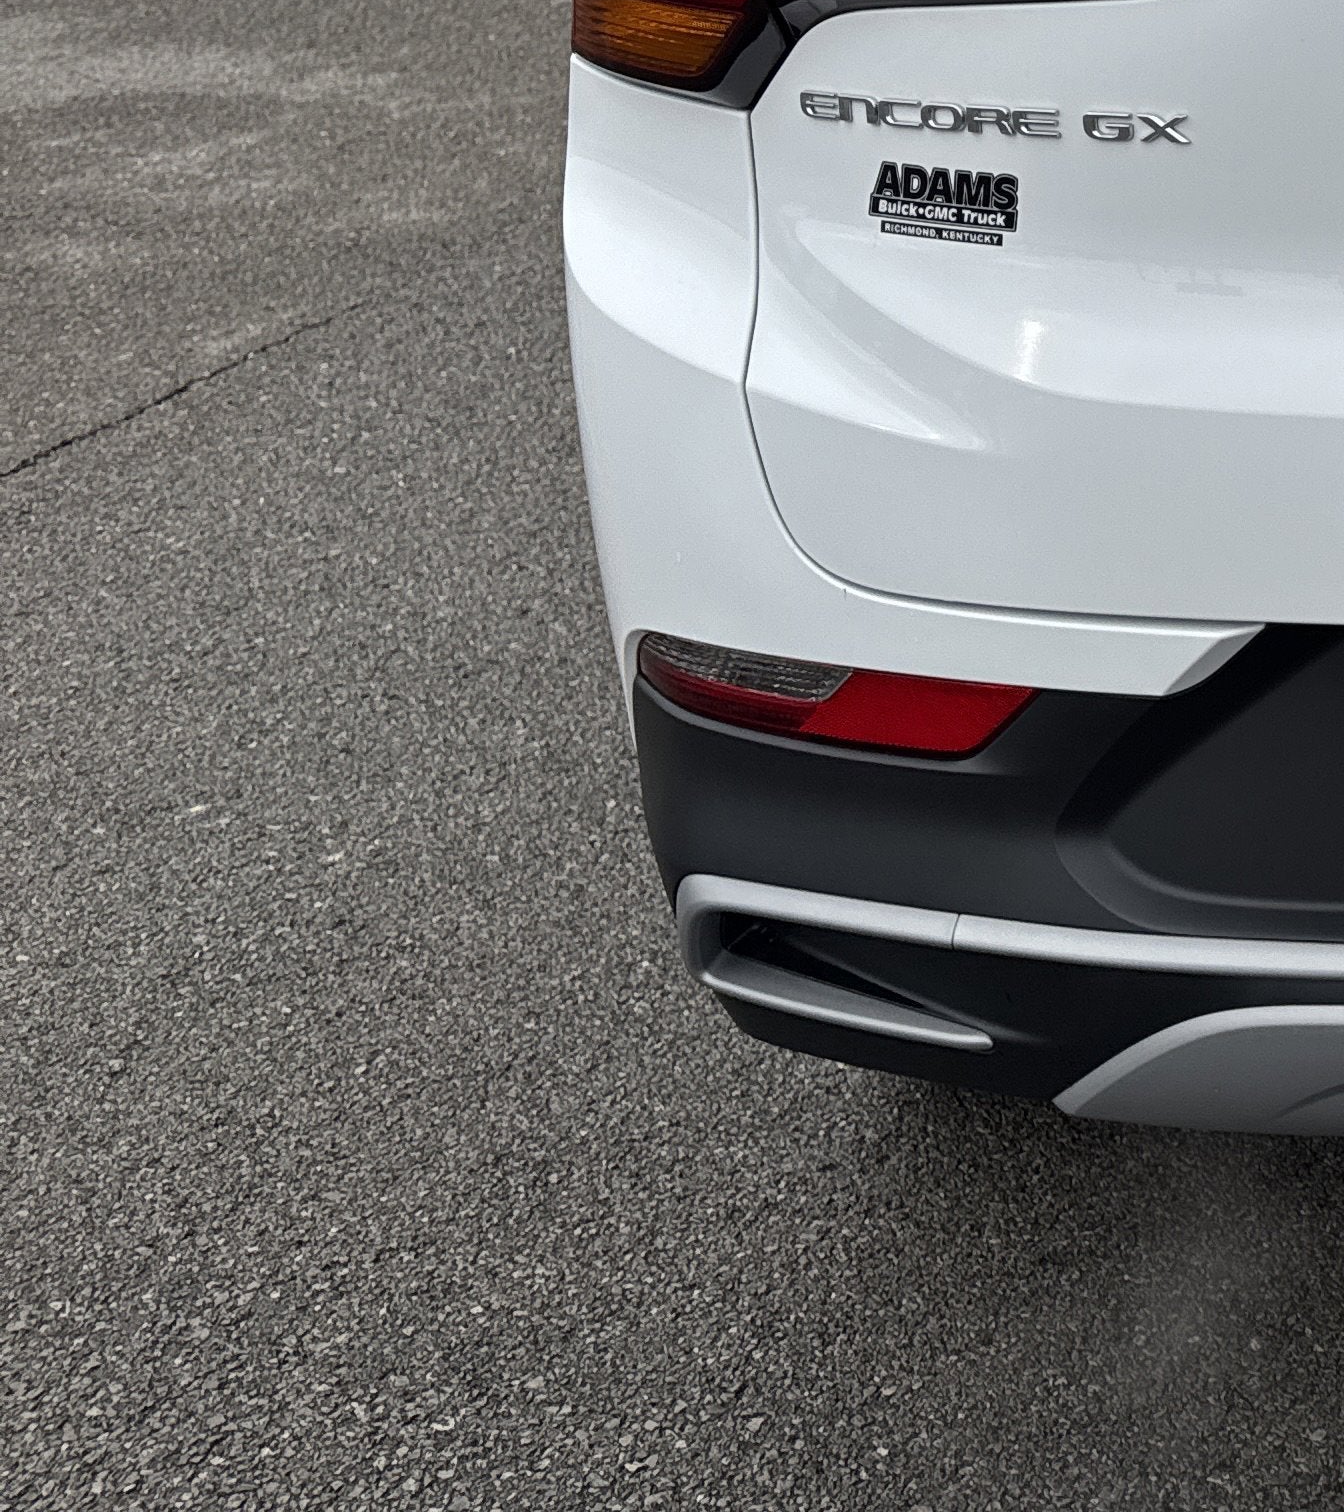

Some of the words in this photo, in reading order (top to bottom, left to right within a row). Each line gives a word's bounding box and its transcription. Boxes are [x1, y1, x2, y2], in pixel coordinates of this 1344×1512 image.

[800, 89, 1062, 140] ENCORE
[1082, 110, 1192, 145] GX
[873, 160, 1019, 211] ADAMS
[884, 222, 939, 239] RICHMOND,
[942, 230, 1000, 245] KENTUCKY
[962, 209, 1007, 227] Truck
